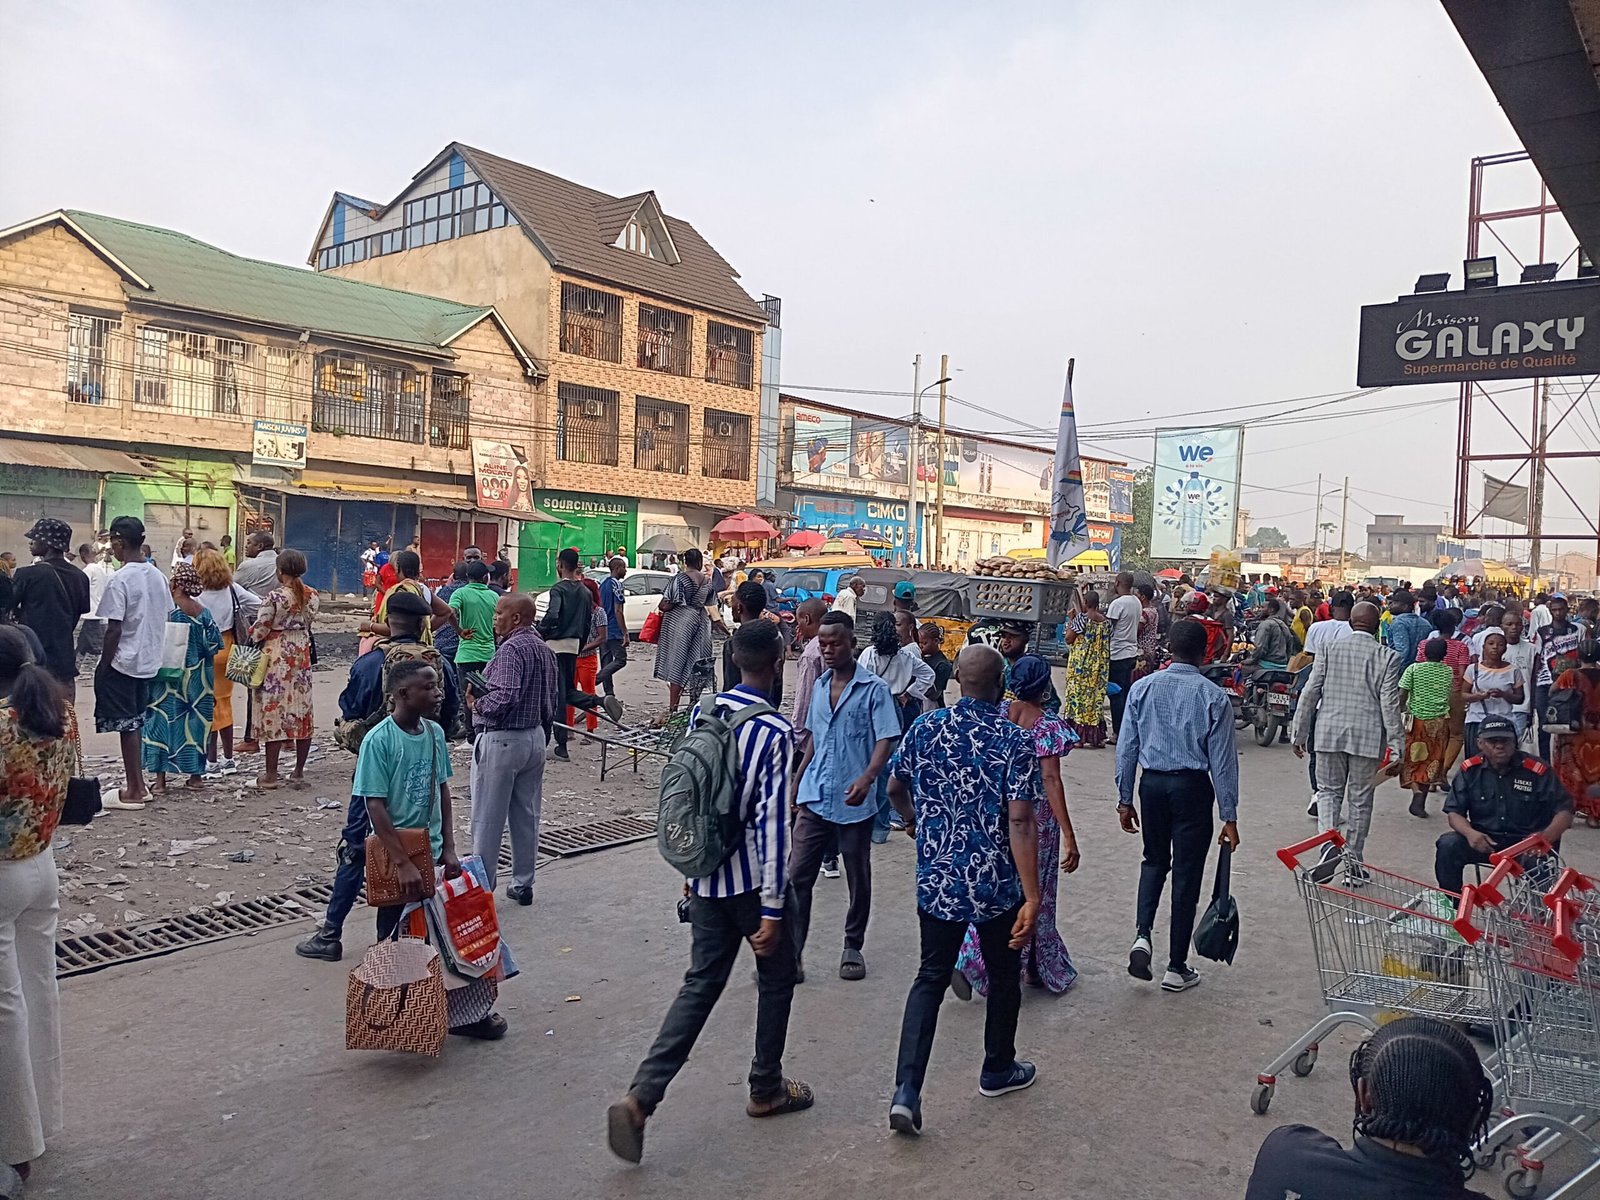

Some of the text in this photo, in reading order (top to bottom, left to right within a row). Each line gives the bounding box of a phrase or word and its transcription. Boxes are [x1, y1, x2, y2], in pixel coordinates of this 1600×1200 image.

[1396, 309, 1480, 334] Maison
[1395, 316, 1585, 361] GALAXY
[1403, 353, 1577, 376] Supermarché de Qualité
[543, 498, 606, 512] SOURCINTA
